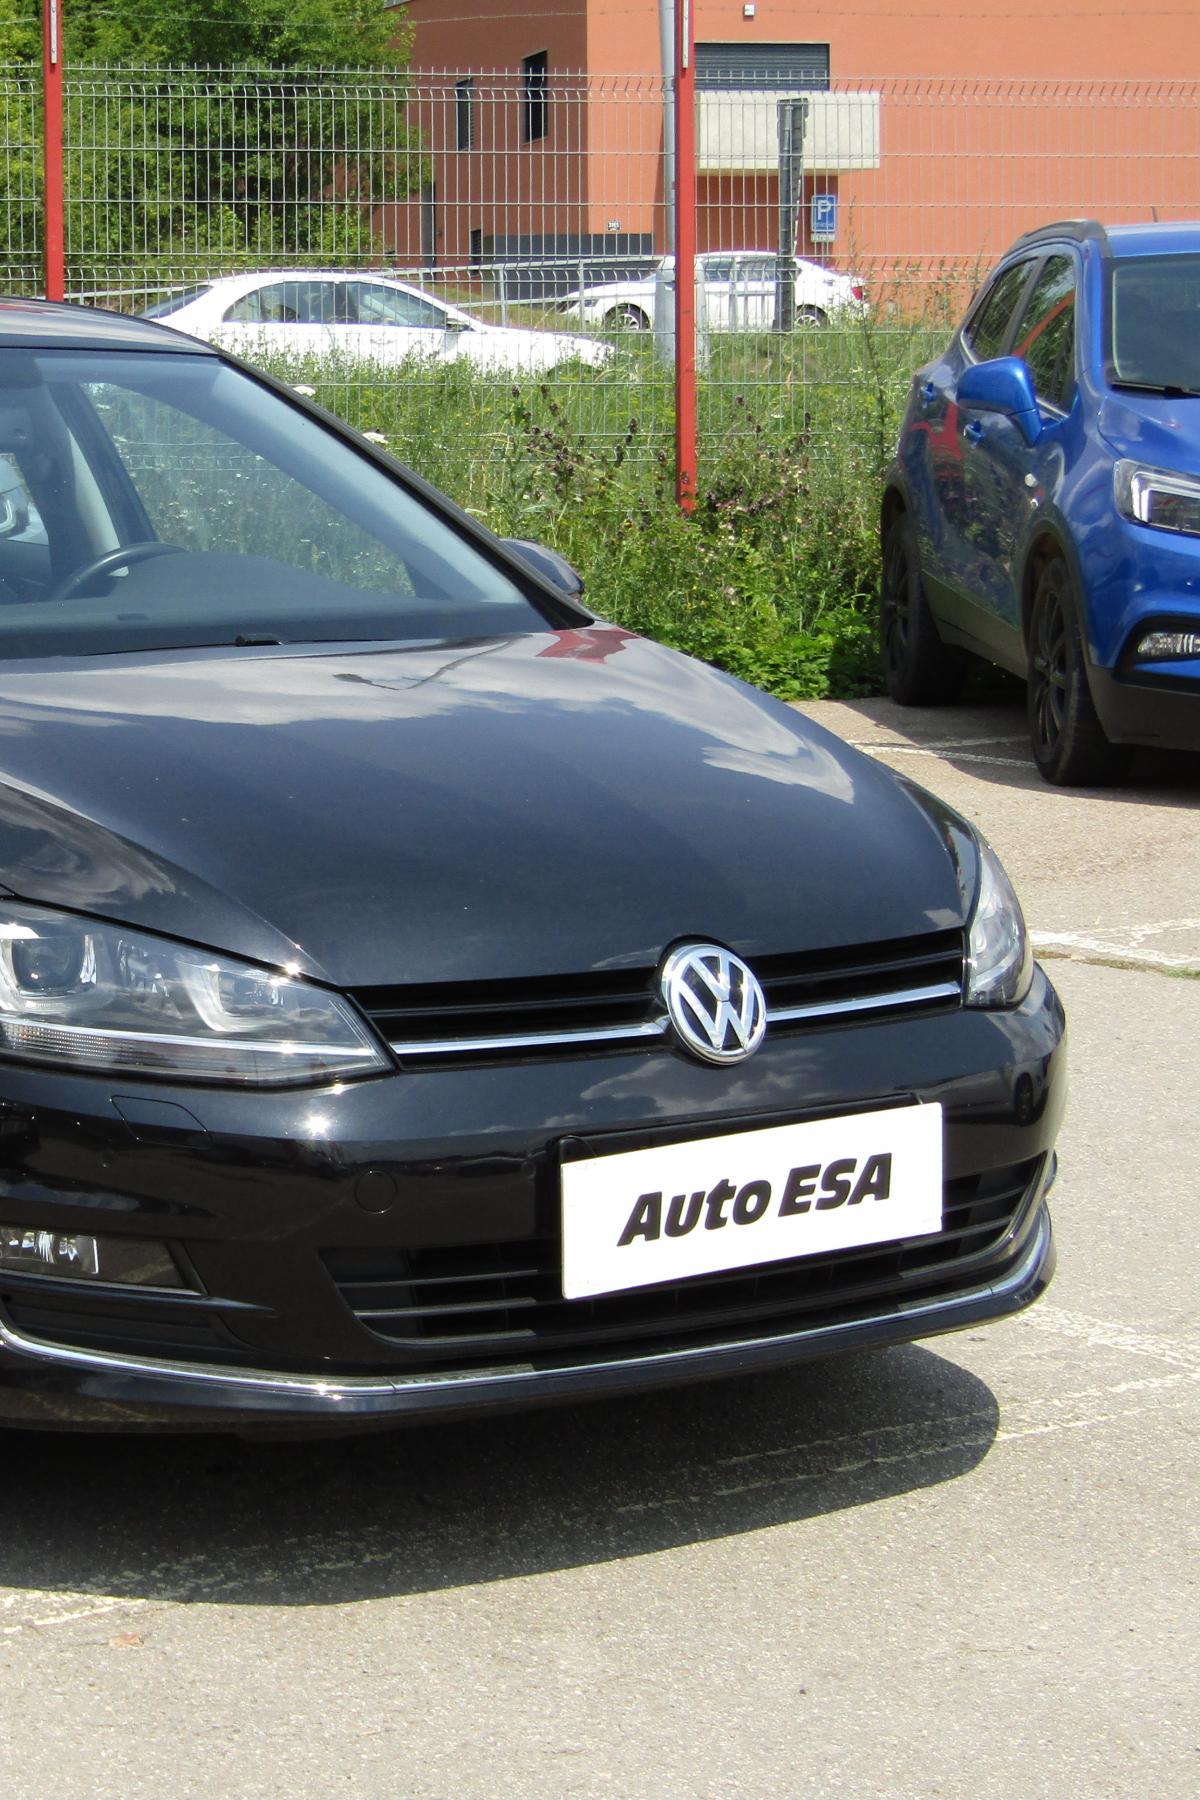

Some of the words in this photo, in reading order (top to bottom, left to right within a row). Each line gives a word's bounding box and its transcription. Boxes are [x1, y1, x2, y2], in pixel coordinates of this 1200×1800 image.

[817, 199, 832, 221] P
[666, 949, 764, 1060] VW
[616, 1178, 772, 1247] Auto
[778, 1152, 893, 1218] ESA
